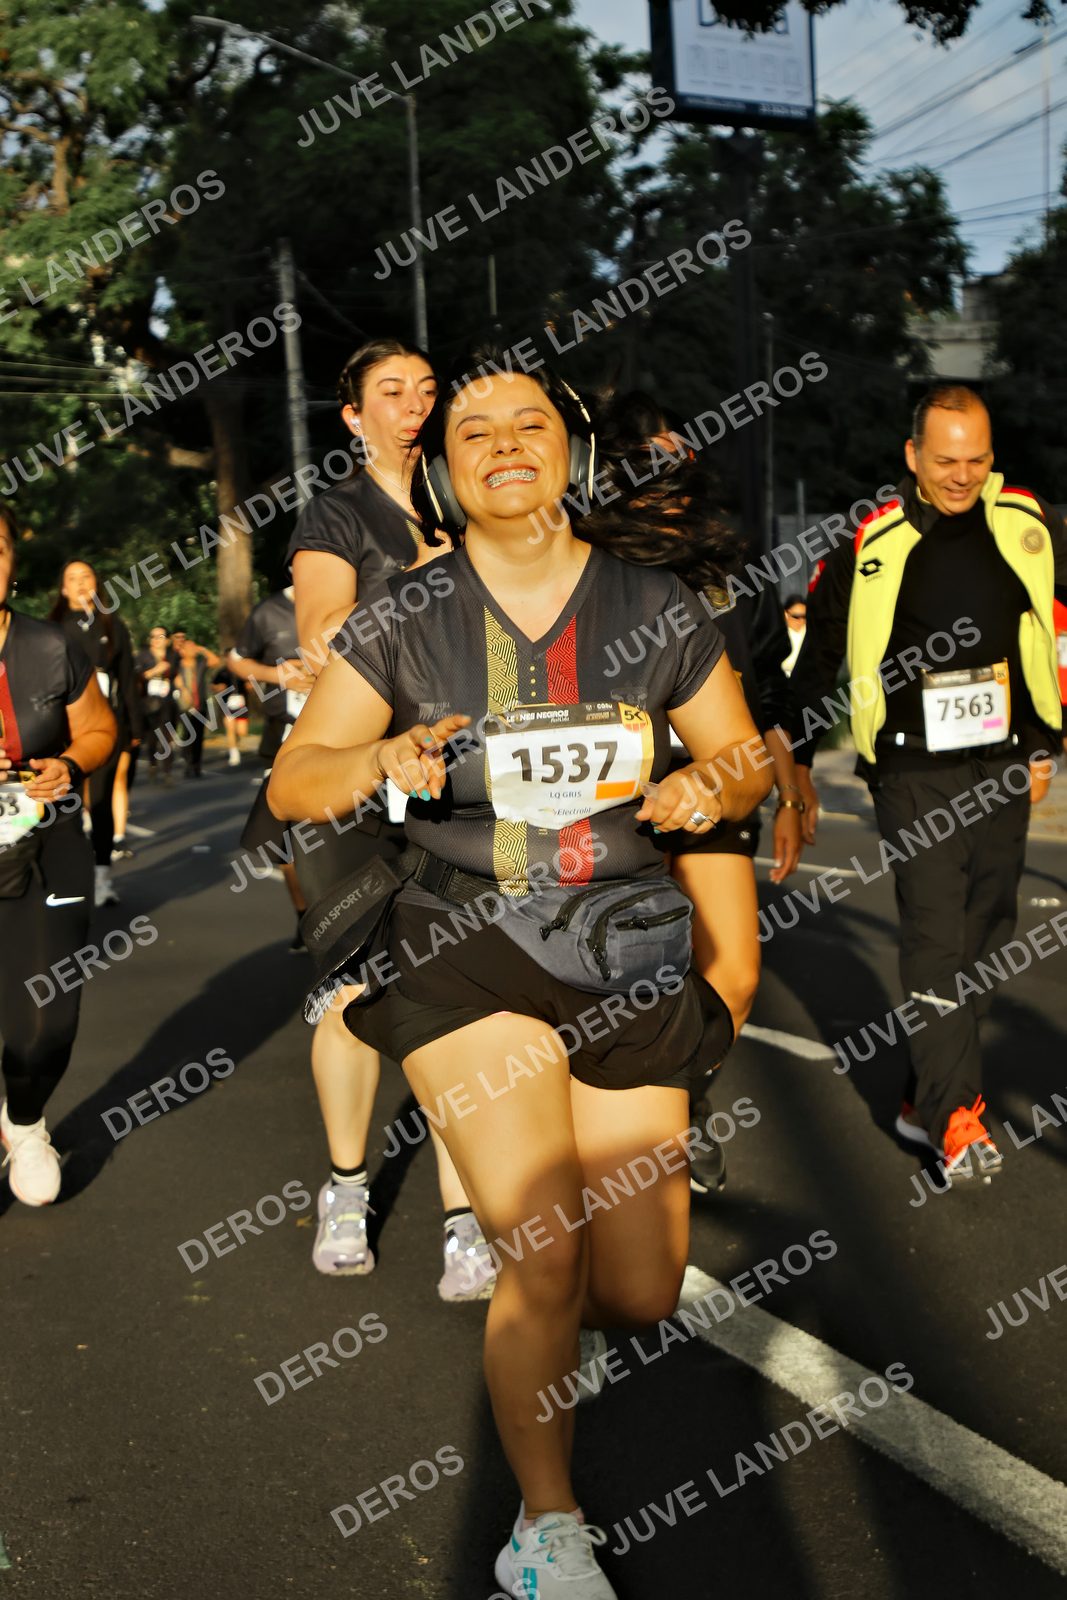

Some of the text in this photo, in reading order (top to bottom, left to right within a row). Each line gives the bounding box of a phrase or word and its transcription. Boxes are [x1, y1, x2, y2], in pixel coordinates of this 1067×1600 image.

[937, 692, 993, 721] 7563
[512, 741, 618, 784] 1537
[562, 790, 582, 798] GRIS
[312, 888, 363, 940] RUN SPORT
